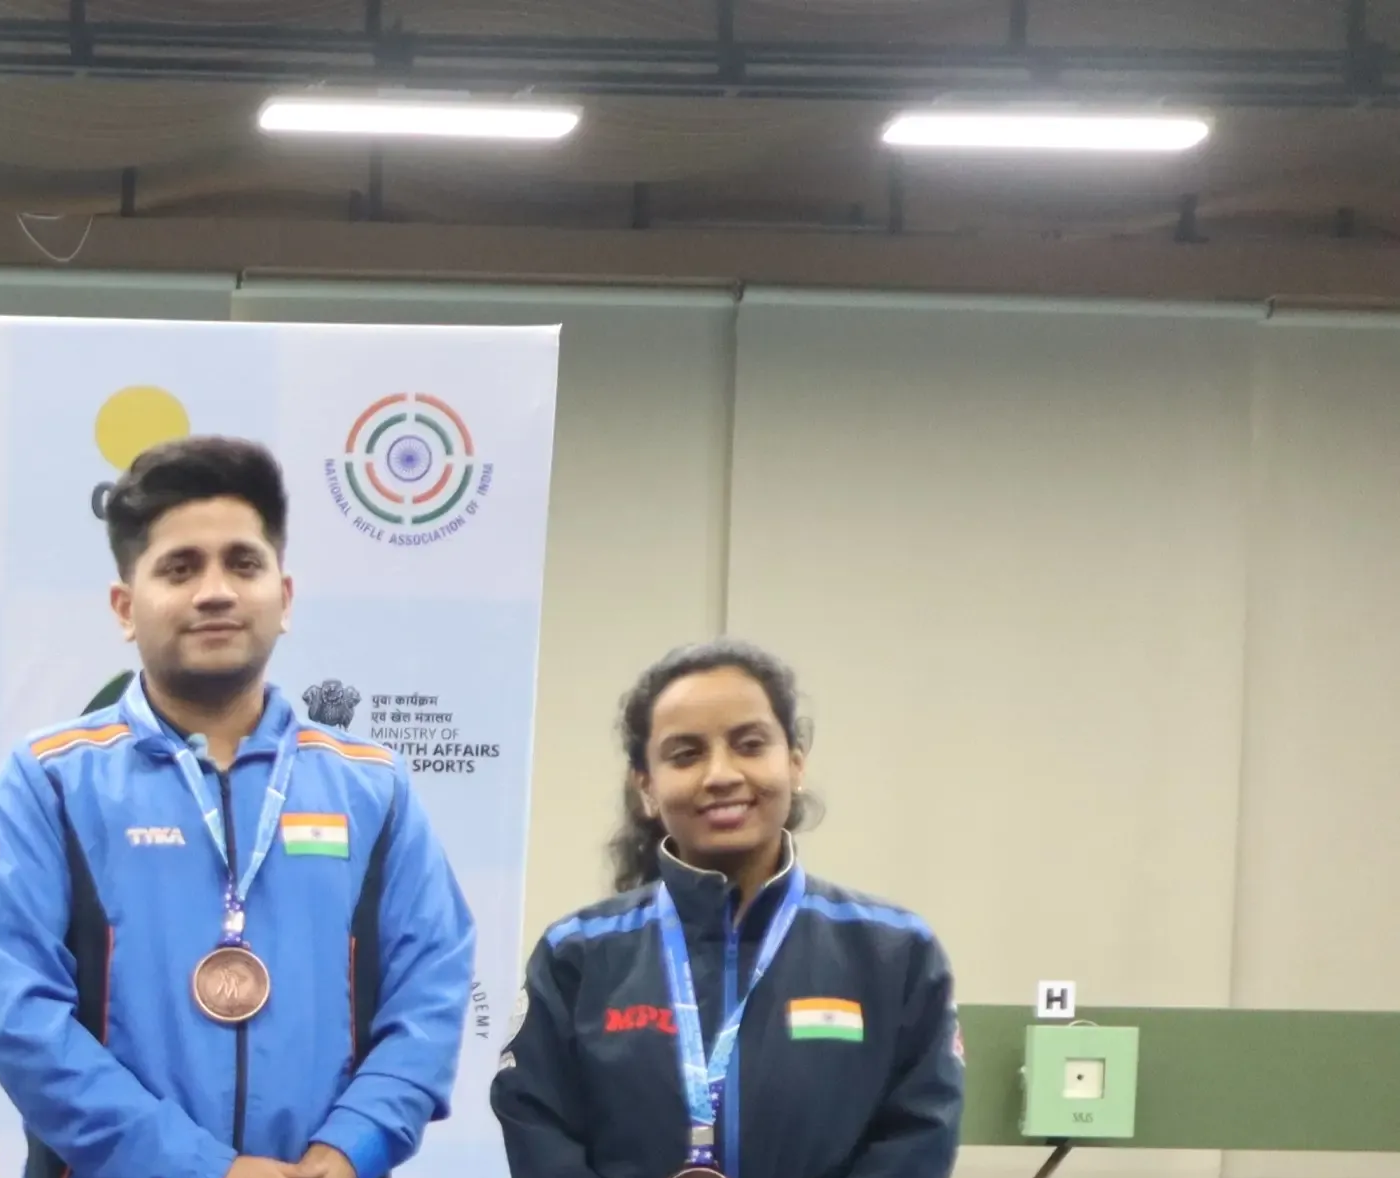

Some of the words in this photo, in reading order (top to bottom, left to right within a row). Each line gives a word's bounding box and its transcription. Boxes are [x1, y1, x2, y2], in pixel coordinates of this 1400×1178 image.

[324, 458, 352, 517] NATIONAL
[353, 516, 385, 541] RIFLE
[388, 515, 466, 545] ASSOCIATION
[465, 499, 480, 515] OF
[477, 463, 493, 496] INDIA
[371, 727, 436, 740] MINISTRY
[441, 727, 460, 740] OF
[382, 742, 427, 756] OUTH
[433, 744, 500, 757] AFFAIRS
[412, 760, 475, 773] SPORTS
[127, 828, 185, 845] TYKA
[1046, 988, 1067, 1010] H
[472, 982, 490, 1039] ADEMY
[606, 1005, 679, 1035] MPL
